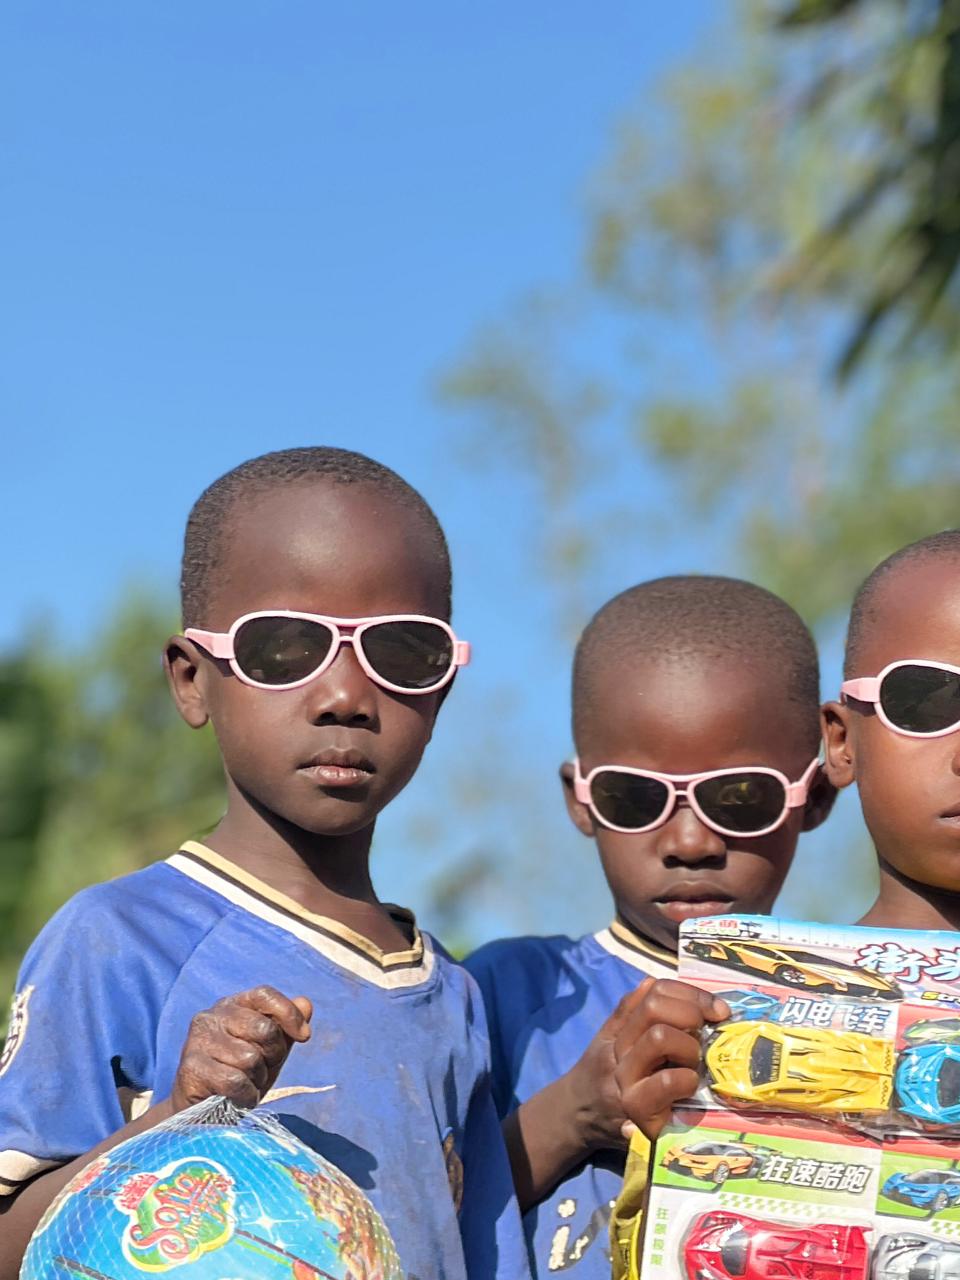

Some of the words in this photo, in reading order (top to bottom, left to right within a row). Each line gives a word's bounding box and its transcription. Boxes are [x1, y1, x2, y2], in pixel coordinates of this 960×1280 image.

[781, 997, 891, 1034] 闪电飞车
[758, 1155, 873, 1194] 狂速酷跑
